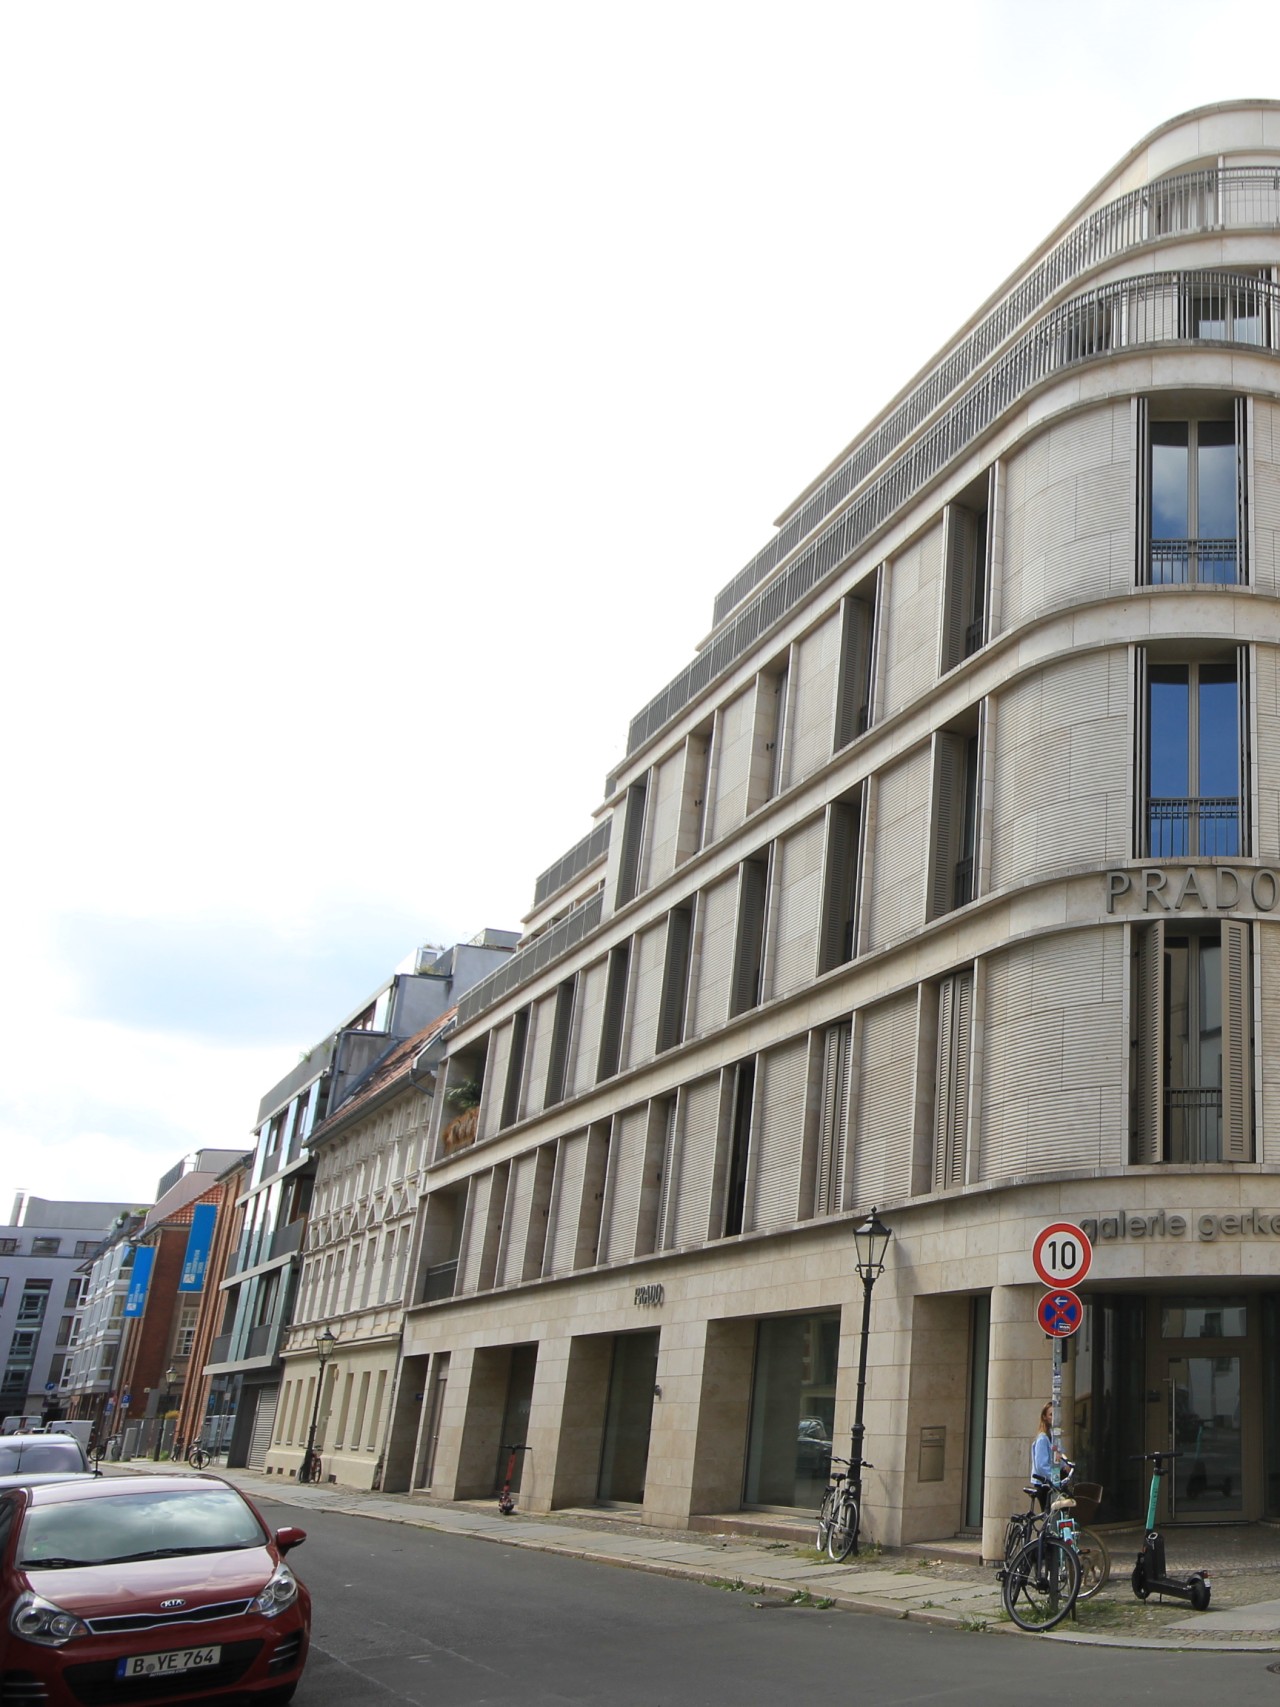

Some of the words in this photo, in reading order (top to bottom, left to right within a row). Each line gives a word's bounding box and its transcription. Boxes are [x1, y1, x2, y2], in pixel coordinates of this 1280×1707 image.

[1106, 866, 1280, 913] PRADO
[1079, 1207, 1187, 1244] galerie
[1047, 1240, 1077, 1270] 10
[163, 1599, 183, 1607] KIA
[132, 1658, 144, 1674] B
[157, 1653, 179, 1670] YE
[183, 1649, 214, 1667] 764
